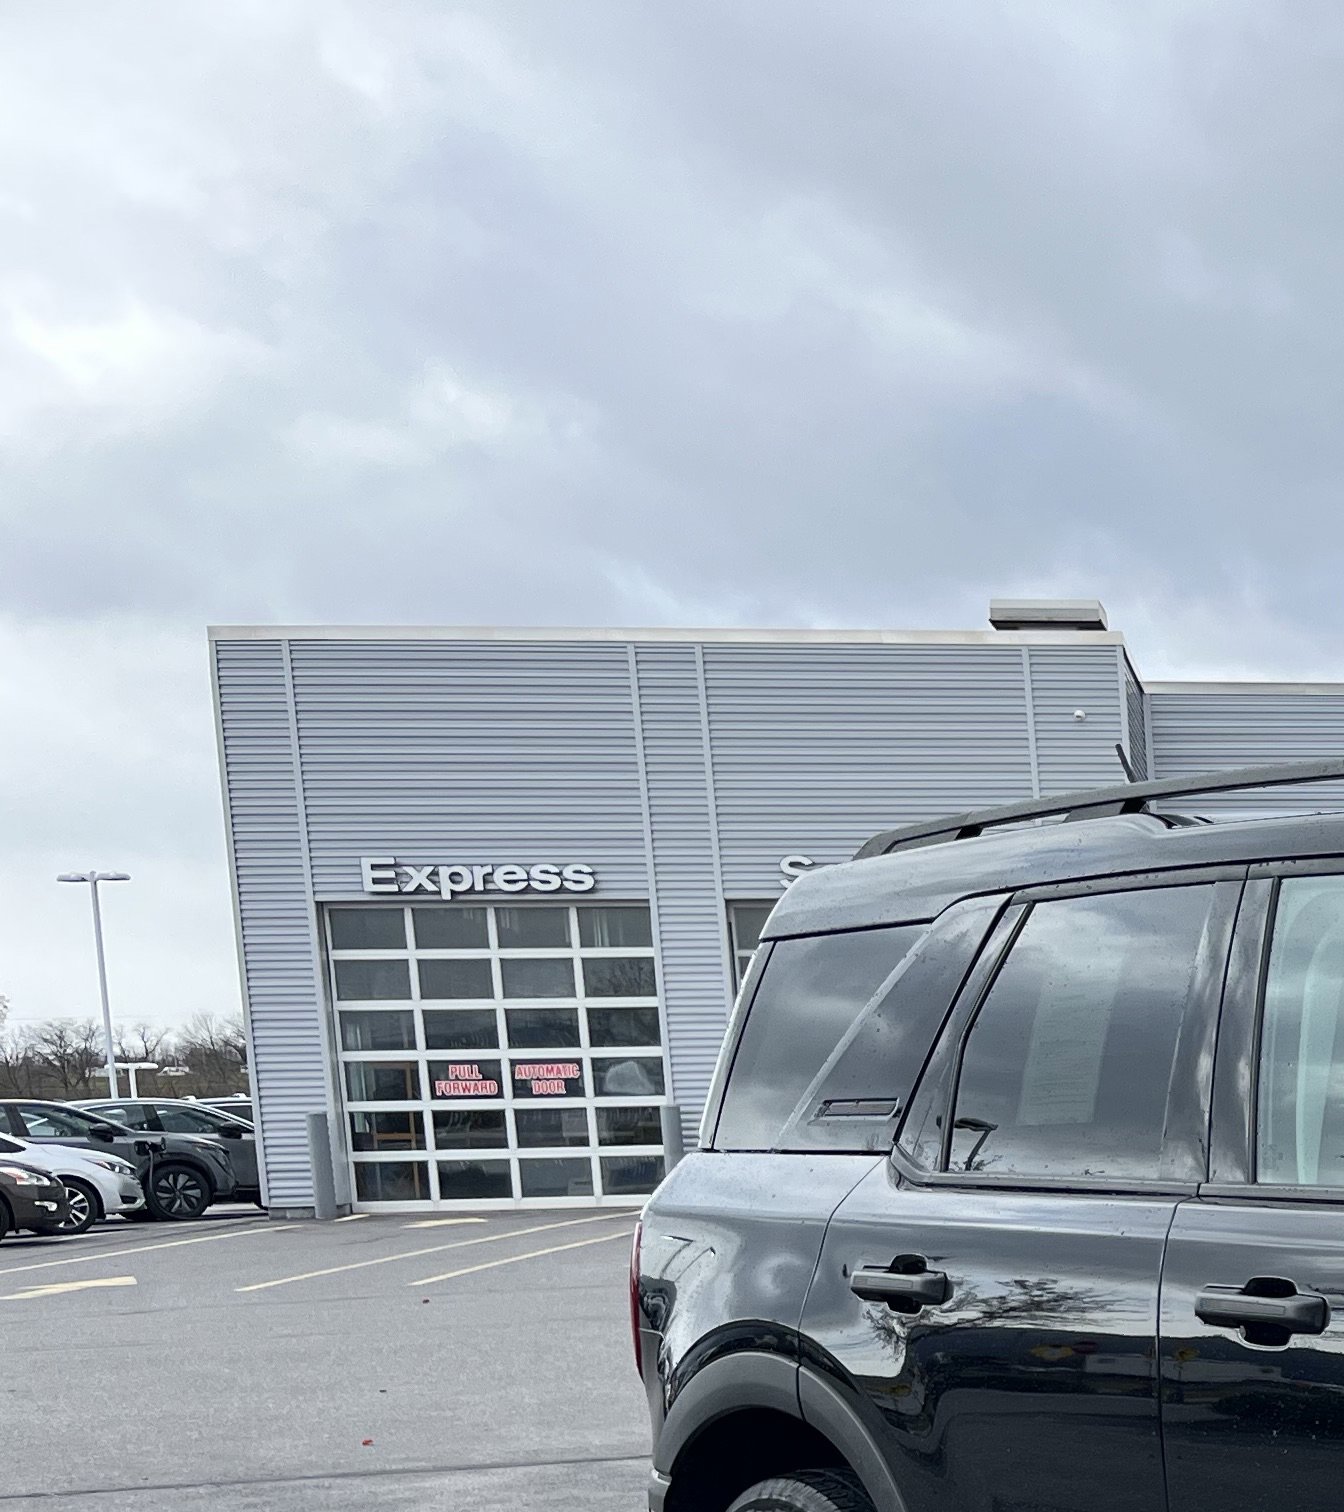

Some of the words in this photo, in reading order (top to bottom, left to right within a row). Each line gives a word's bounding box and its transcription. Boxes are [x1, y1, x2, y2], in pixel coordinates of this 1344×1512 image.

[360, 856, 597, 900] Express
[448, 1064, 482, 1080] PULL
[515, 1063, 581, 1079] AUTOMATIC
[435, 1080, 498, 1096] FORWARD
[532, 1080, 566, 1095] DOOR
